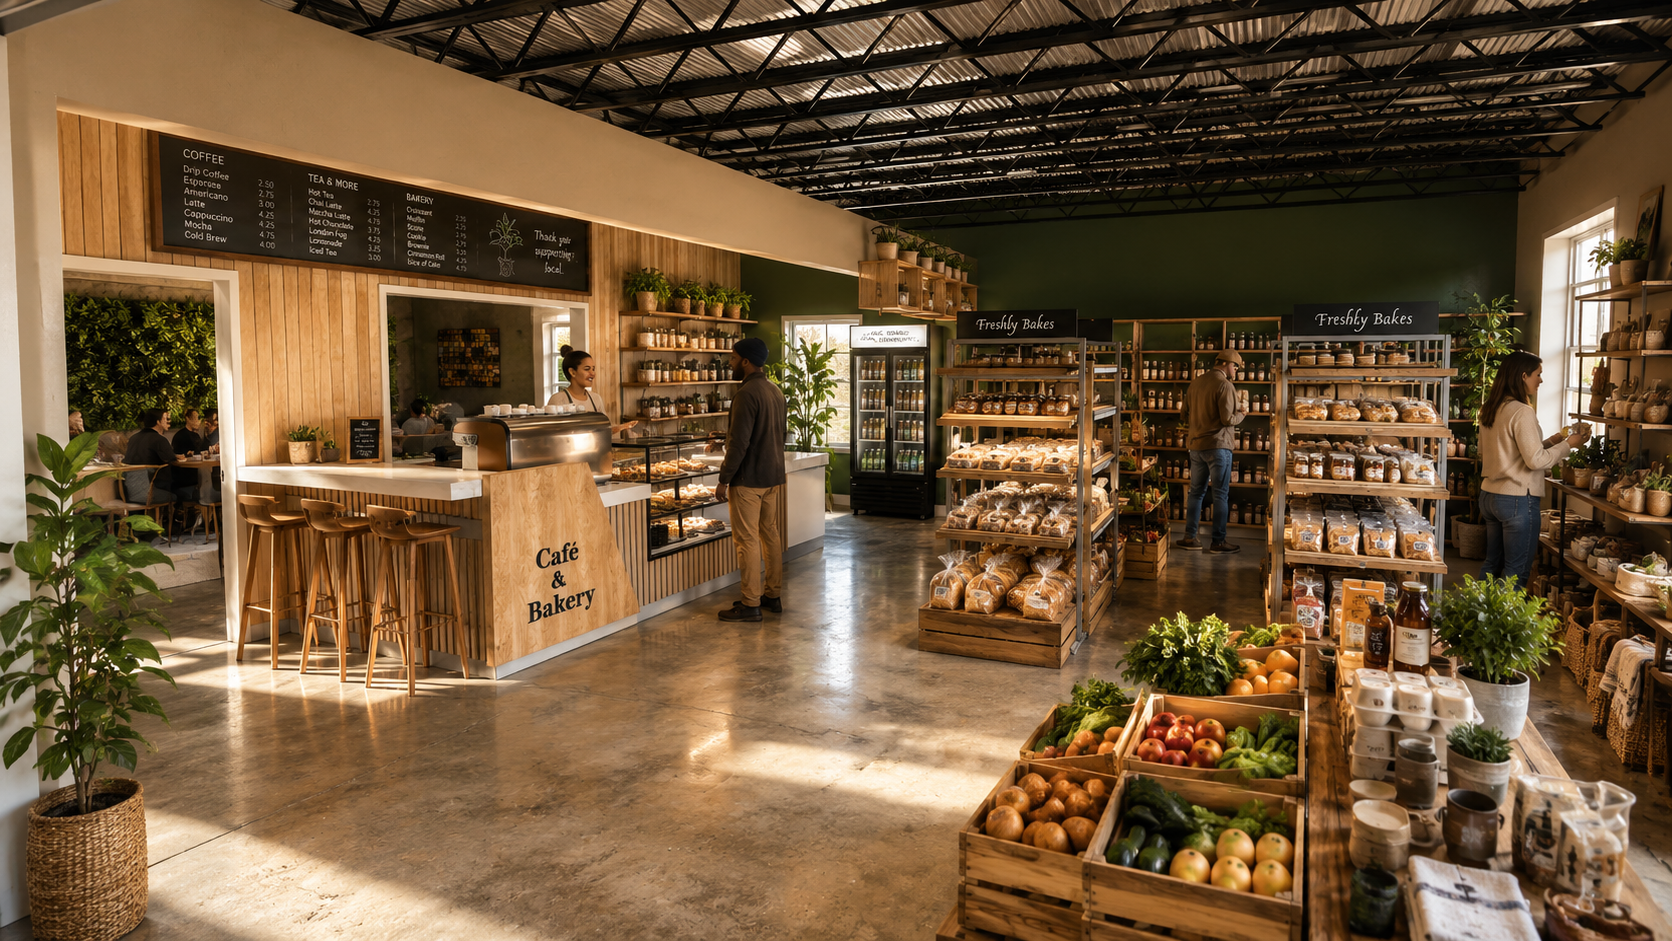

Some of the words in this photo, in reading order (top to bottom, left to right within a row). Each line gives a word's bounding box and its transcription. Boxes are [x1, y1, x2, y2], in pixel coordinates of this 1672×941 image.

[183, 148, 224, 165] COFFEE
[183, 165, 200, 176] Drip
[203, 168, 230, 181] Coffee
[308, 173, 325, 184] TEA
[327, 177, 332, 186] &
[335, 179, 359, 191] MORE
[184, 198, 206, 208] Latte
[184, 208, 233, 223] Cappuccino
[184, 220, 212, 230] Mocha
[185, 230, 204, 240] Cold
[206, 233, 227, 243] Brew
[976, 314, 1018, 336] Freshly
[1022, 314, 1055, 330] Bakes
[1373, 308, 1413, 325] Bakes
[536, 541, 579, 569] Café
[551, 570, 566, 589] &
[527, 588, 596, 624] Bakery
